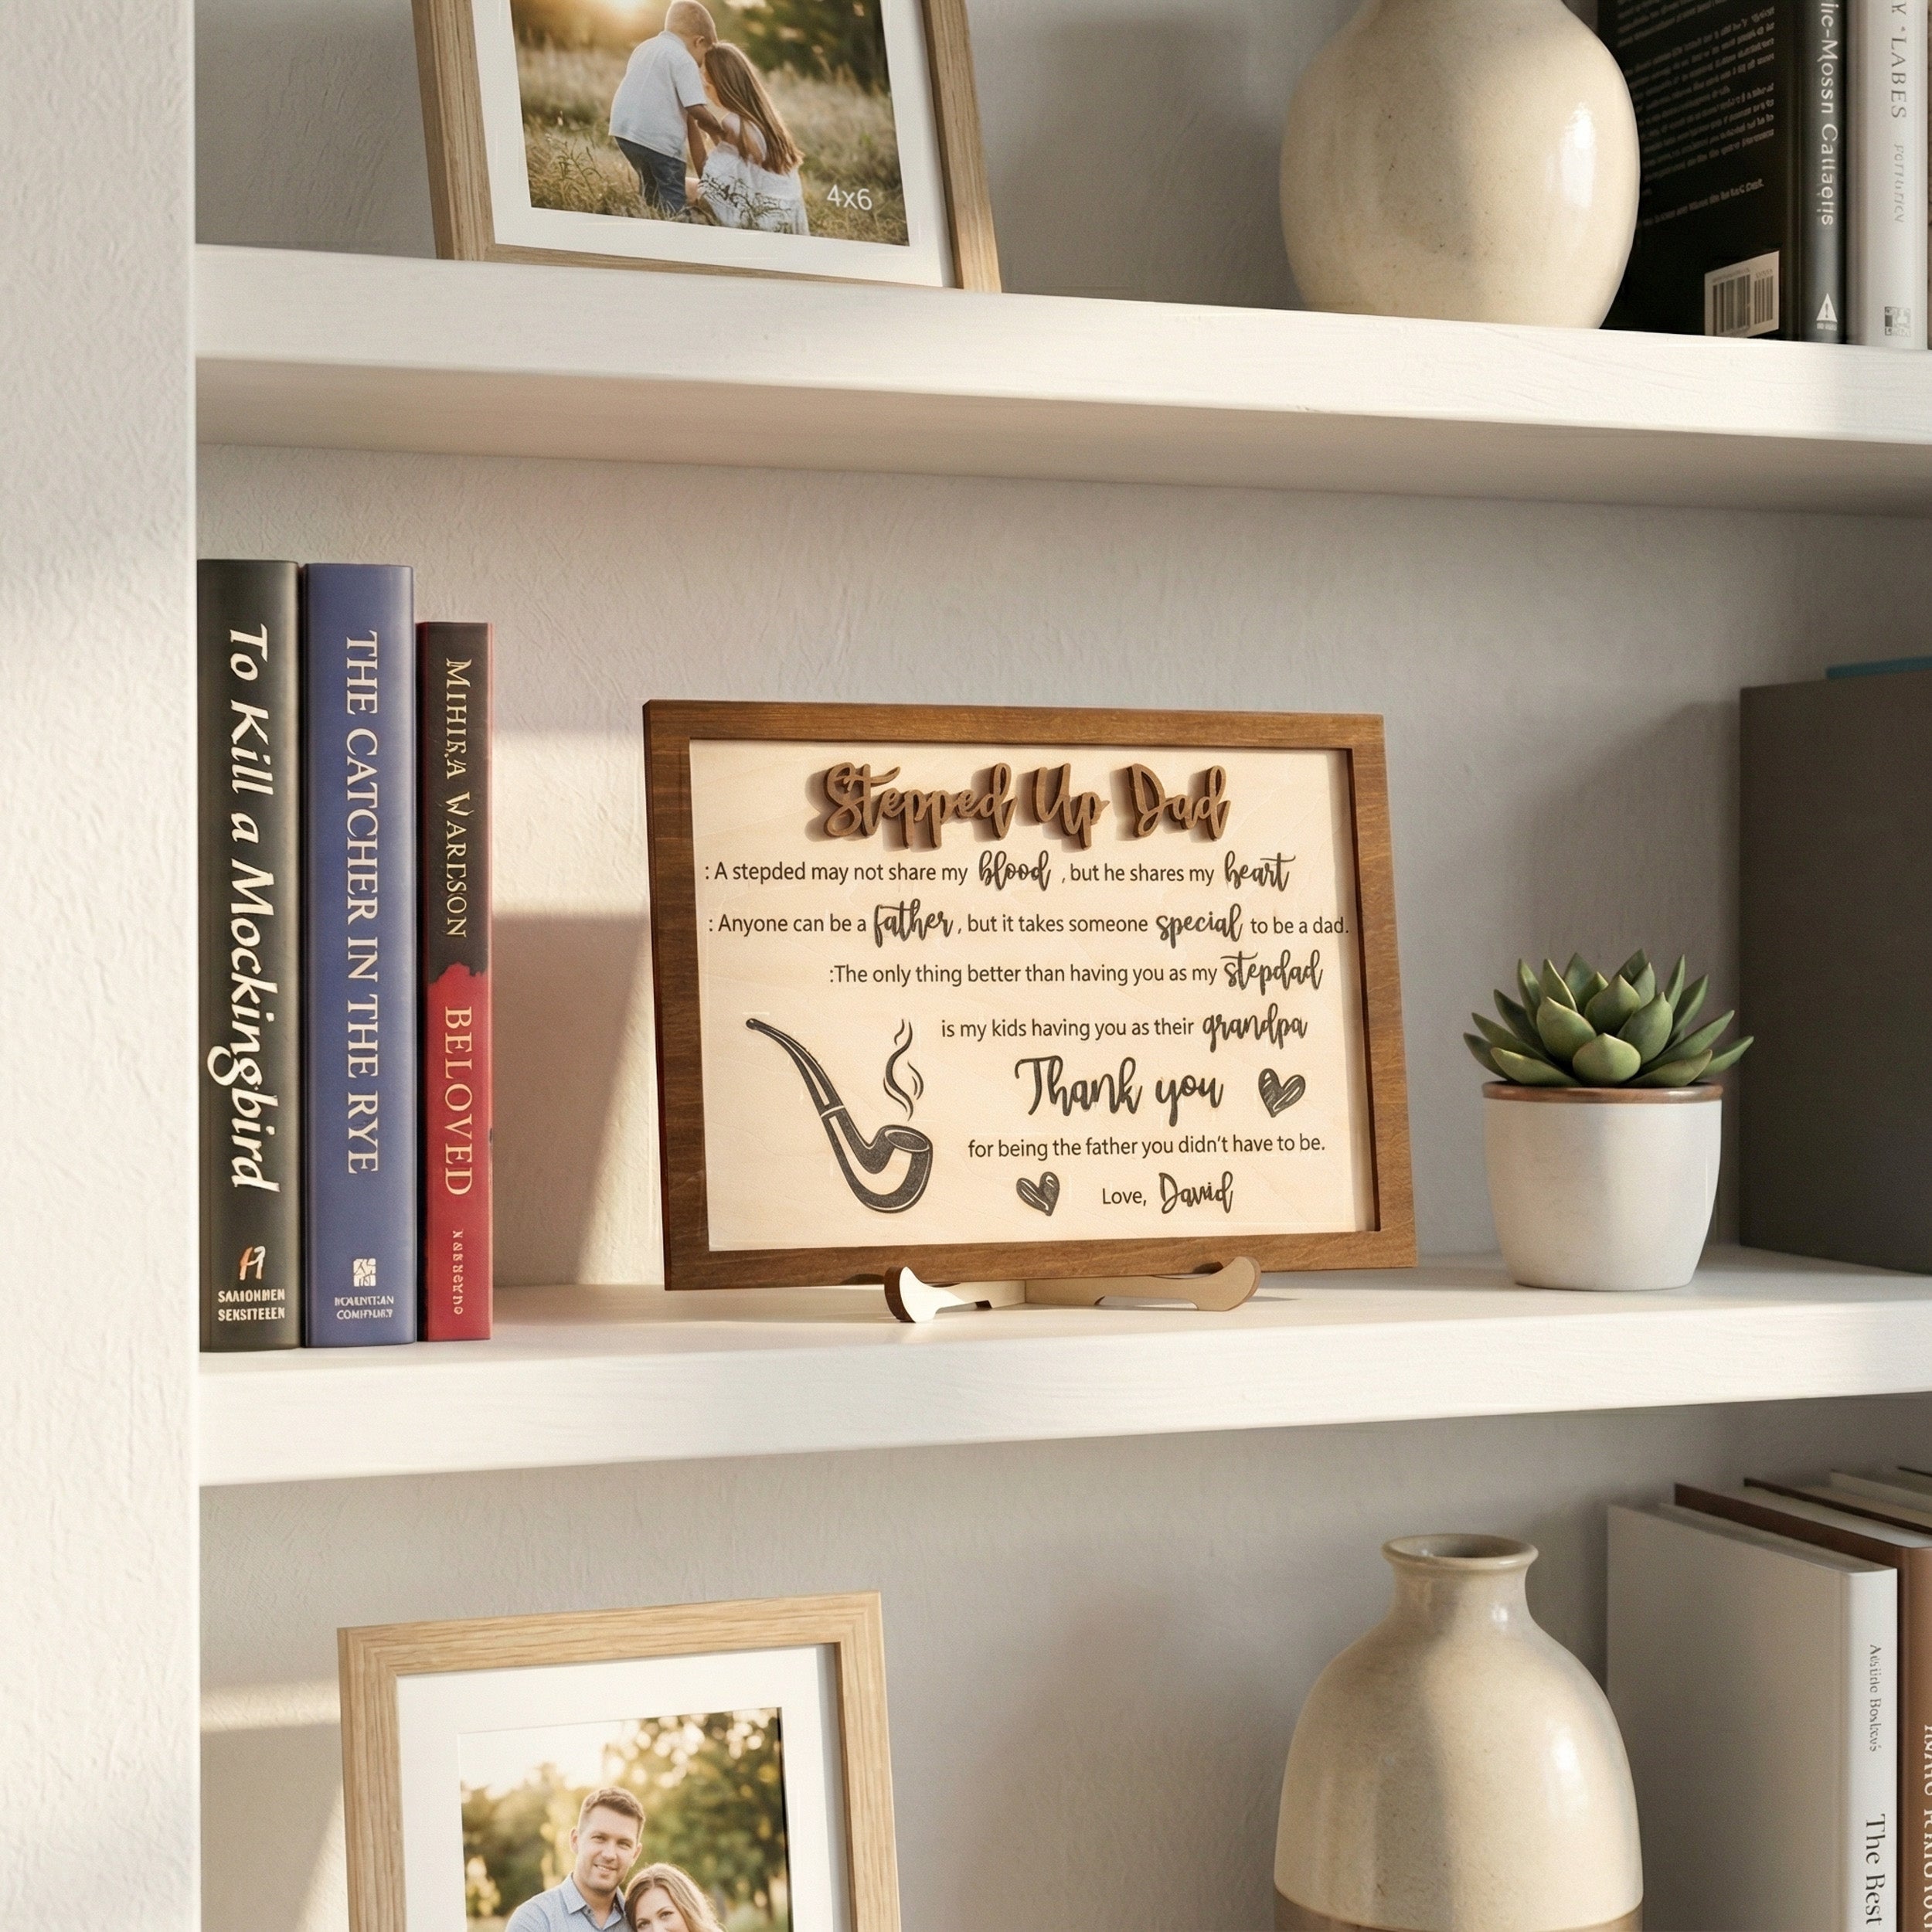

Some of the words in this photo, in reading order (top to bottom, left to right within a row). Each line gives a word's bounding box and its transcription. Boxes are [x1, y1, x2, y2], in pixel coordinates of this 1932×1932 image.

[827, 184, 872, 210] 4x6
[230, 623, 268, 682] To
[346, 629, 379, 715] THE
[230, 699, 274, 795] Kill
[231, 812, 259, 844] a
[346, 728, 379, 925] CATCHER
[823, 761, 1019, 849] Stepped
[1032, 762, 1111, 850] Up
[1127, 763, 1231, 841] Dad
[713, 861, 729, 880] A
[732, 861, 806, 886] stepded
[811, 866, 849, 886] may
[854, 863, 884, 881] not
[888, 862, 937, 881] share
[941, 866, 969, 886] my
[978, 849, 1052, 892] blood
[1070, 862, 1100, 882] but
[1104, 862, 1125, 882] he
[1129, 863, 1185, 883] shares
[1189, 868, 1215, 887] my
[1223, 849, 1297, 893] heart
[717, 913, 788, 937] Anyone
[792, 918, 825, 933] can
[829, 913, 852, 933] be
[856, 918, 867, 933] a
[967, 913, 998, 933] but
[1002, 913, 1015, 933] it
[1018, 913, 1065, 933] takes
[1068, 918, 1148, 933] someone
[1155, 903, 1243, 950] special
[1250, 918, 1269, 934] to
[1273, 917, 1294, 934] be
[1298, 920, 1308, 934] a
[1312, 915, 1349, 934] dad.
[347, 937, 379, 982] IN
[872, 964, 912, 987] only
[915, 964, 962, 988] thing
[967, 964, 1021, 983] better
[1026, 964, 1065, 982] than
[1070, 963, 1128, 986] having
[1132, 968, 1165, 987] you
[1168, 968, 1188, 981] as
[1192, 968, 1218, 986] my
[1219, 948, 1324, 996] stepdad
[206, 858, 281, 1193] Mockingbird
[347, 993, 379, 1079] THE
[941, 1019, 955, 1038] is
[960, 1023, 988, 1042] my
[992, 1018, 1027, 1037] kids
[1031, 1019, 1090, 1042] having
[1094, 1022, 1127, 1042] you
[1131, 1022, 1150, 1036] as
[1153, 1017, 1195, 1036] their
[1202, 1002, 1308, 1053] grandpa
[444, 1006, 473, 1196] BELOVED
[1014, 1054, 1144, 1117] Thank
[1155, 1074, 1224, 1128] you
[347, 1091, 379, 1175] RYE
[967, 1138, 995, 1158] for
[998, 1139, 1049, 1162] being
[1052, 1138, 1082, 1157] the
[1086, 1137, 1138, 1156] father
[1141, 1140, 1174, 1159] you
[1233, 1134, 1274, 1153] have
[1277, 1135, 1295, 1151] to
[1299, 1133, 1325, 1151] be.
[1102, 1187, 1147, 1207] Love,
[1158, 1170, 1234, 1215] David
[1866, 1813, 1886, 1865] The
